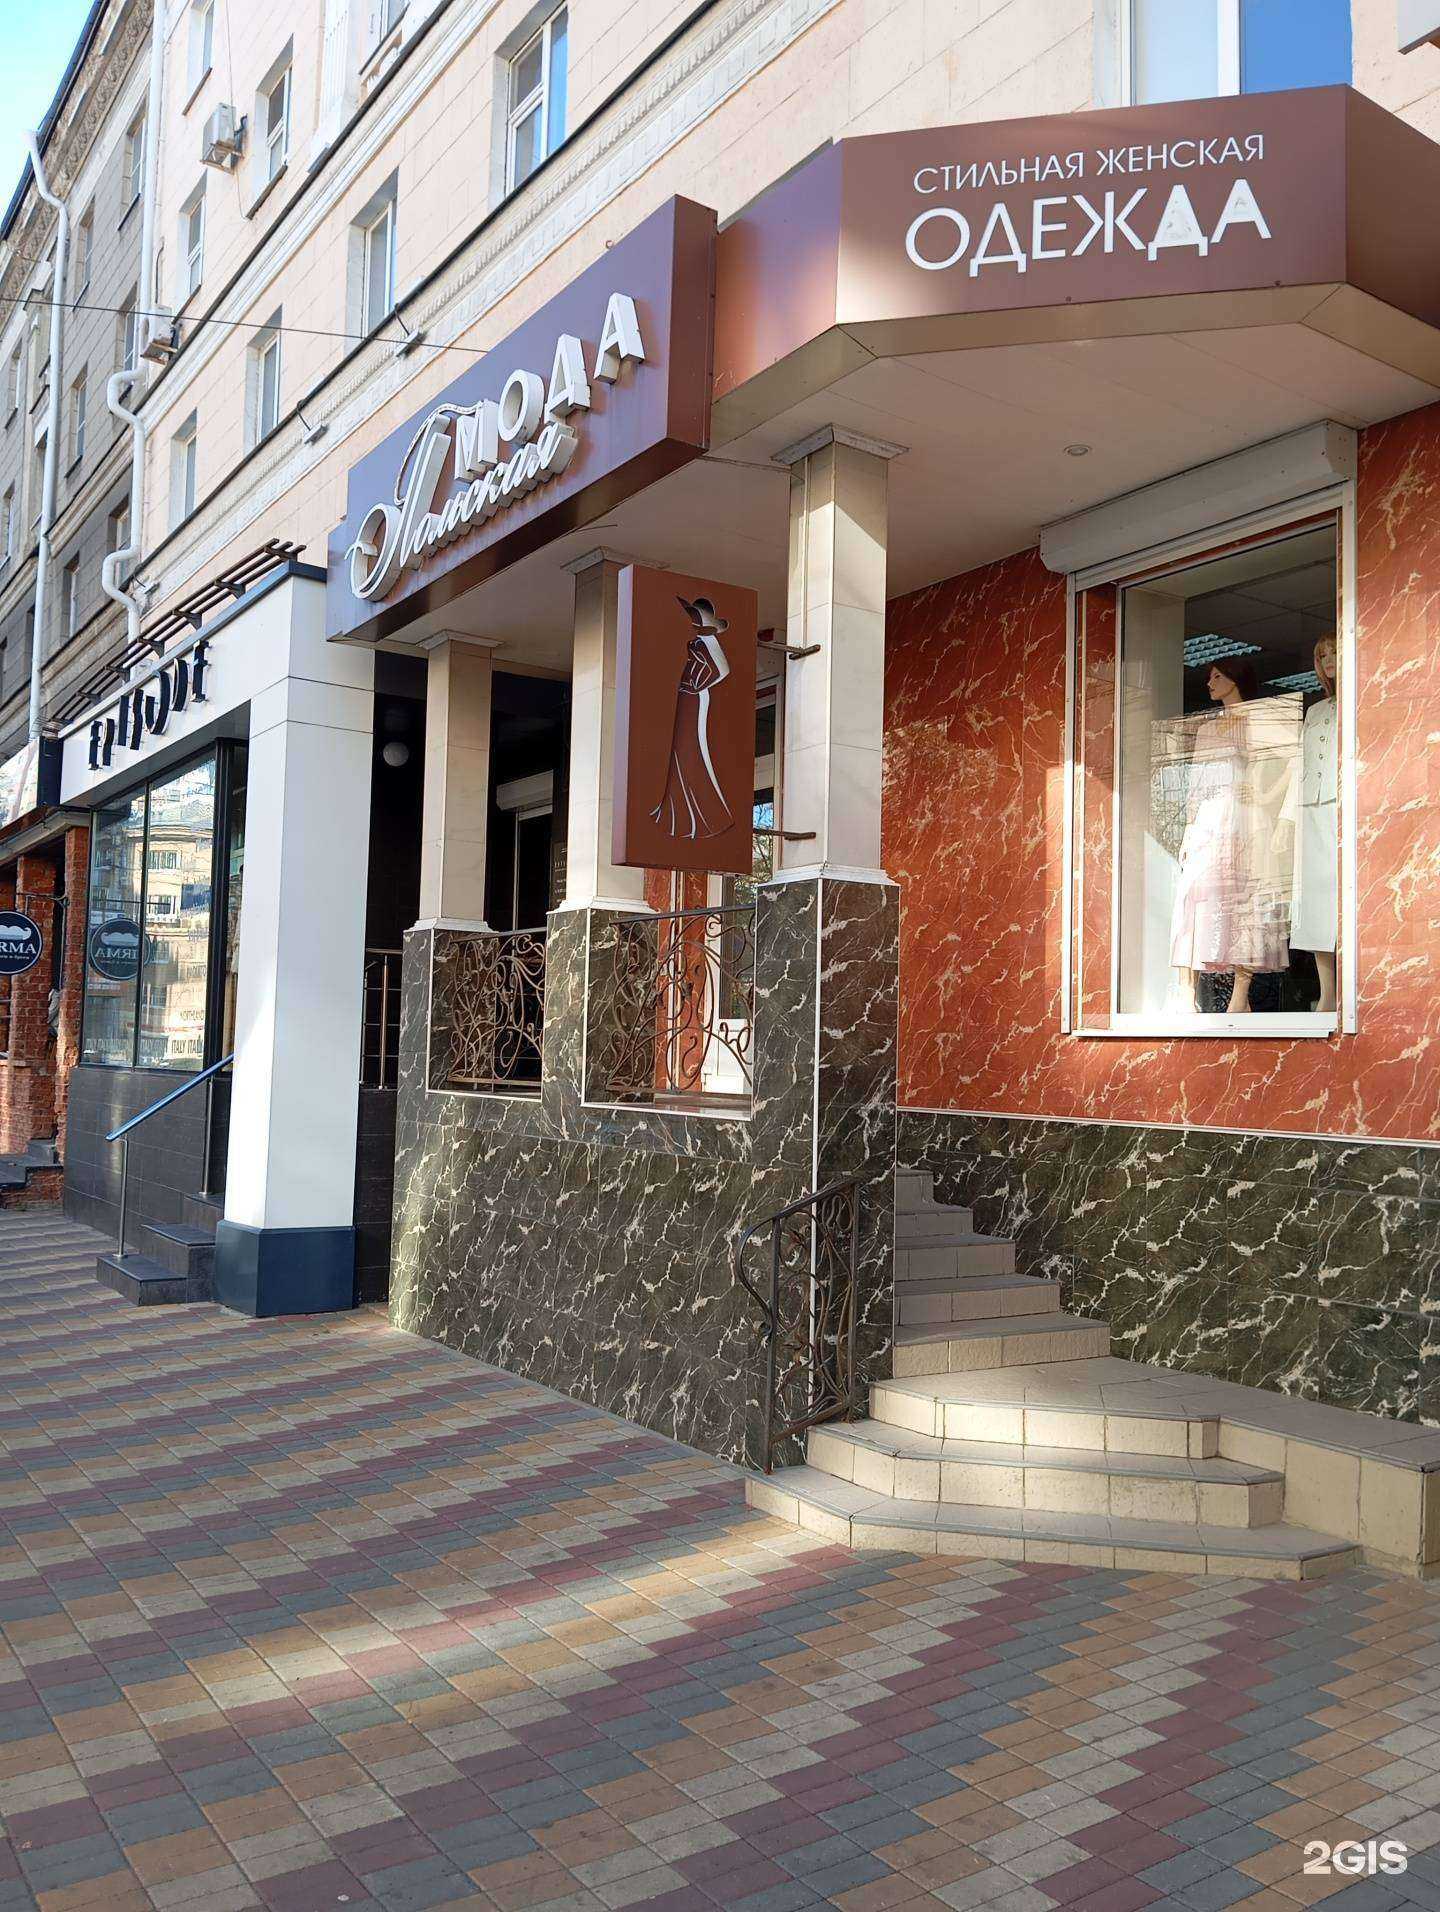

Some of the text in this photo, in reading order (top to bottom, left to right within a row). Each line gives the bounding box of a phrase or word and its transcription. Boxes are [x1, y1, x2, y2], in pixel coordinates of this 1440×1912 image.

[913, 134, 1265, 194] СТИЛЬНАЯ ЖЕНСКАЯ
[905, 178, 1272, 278] ОДЕЖДА
[453, 292, 645, 483] МОДА
